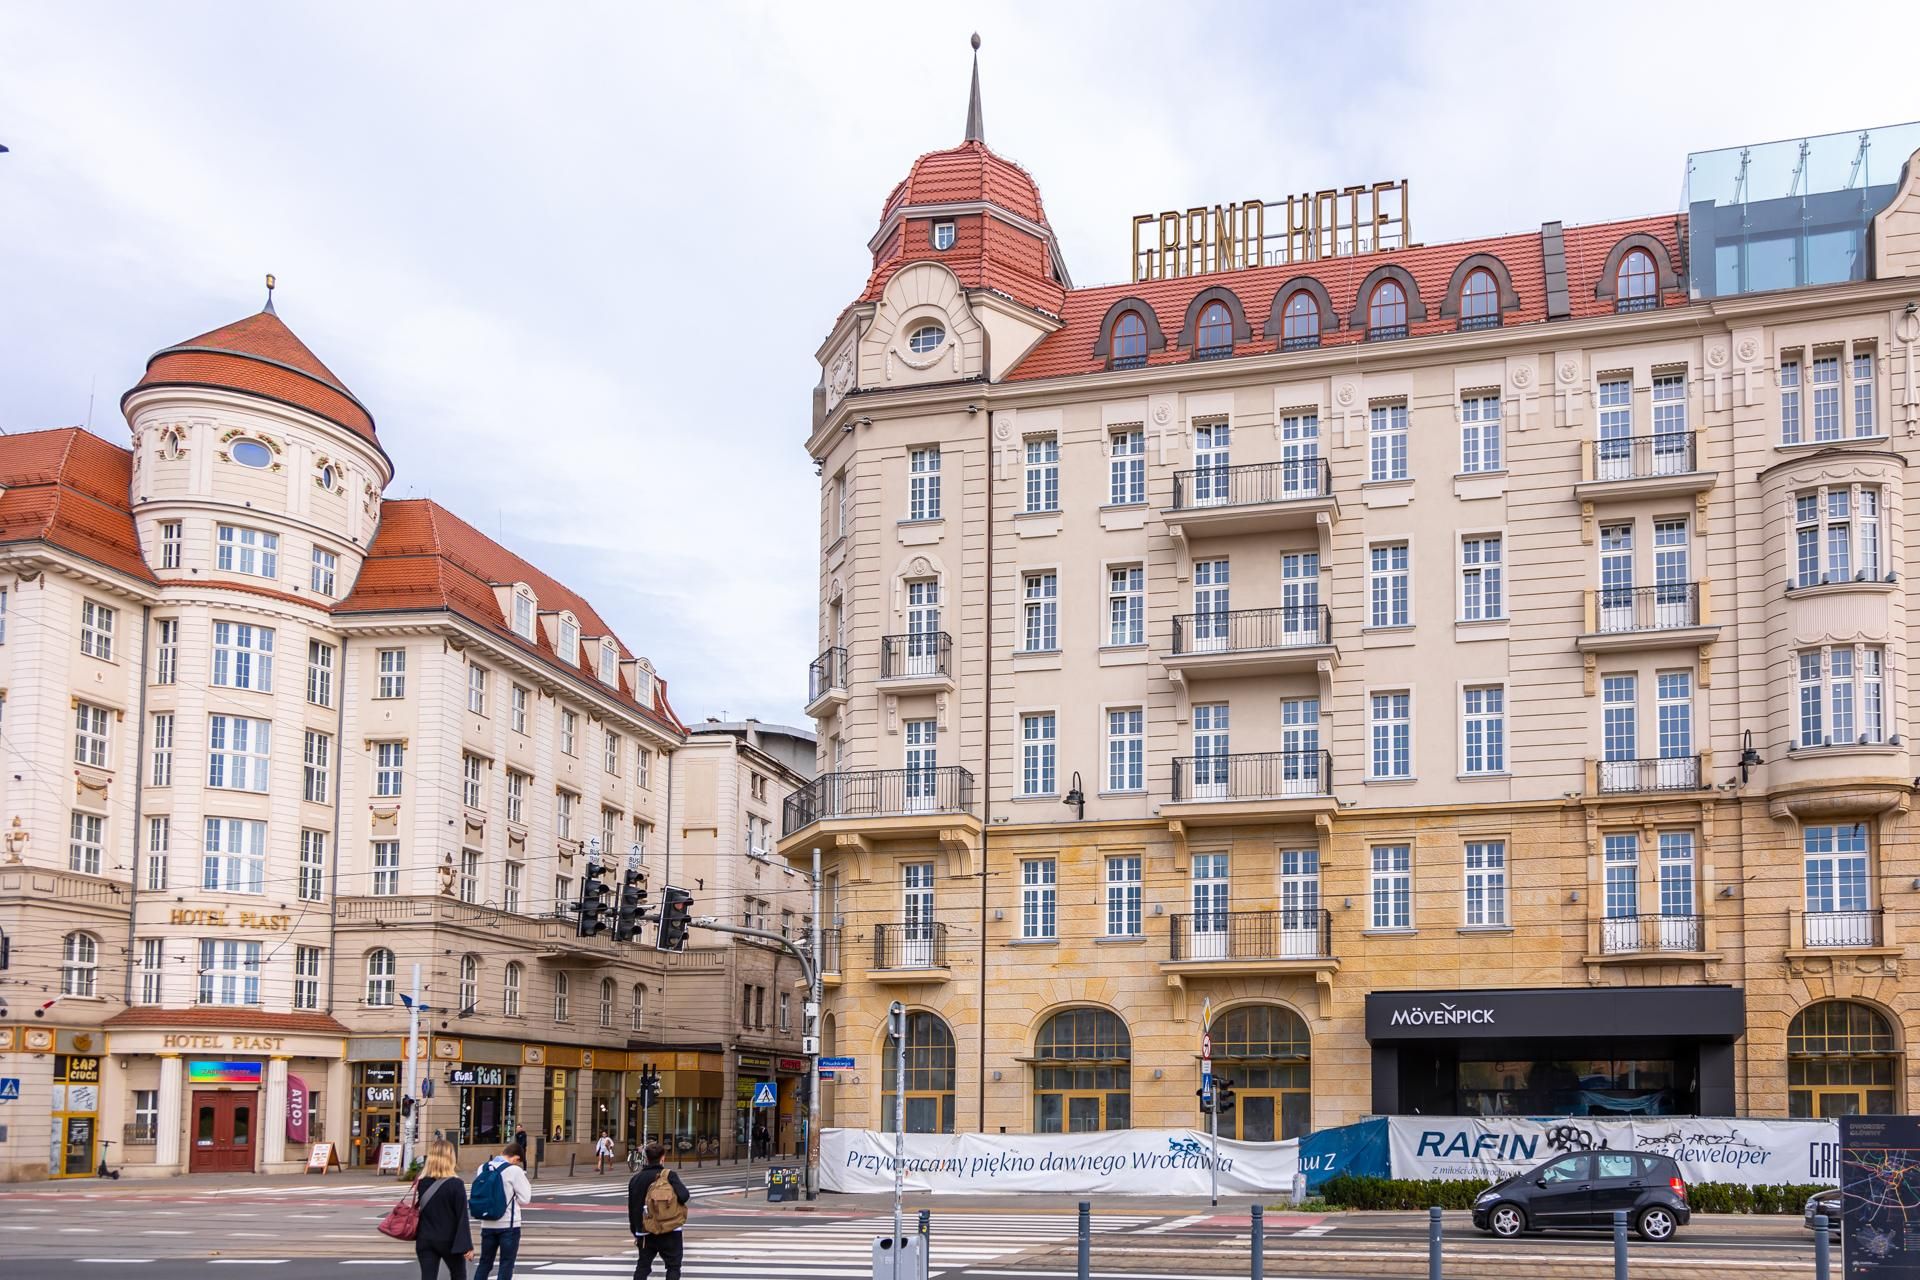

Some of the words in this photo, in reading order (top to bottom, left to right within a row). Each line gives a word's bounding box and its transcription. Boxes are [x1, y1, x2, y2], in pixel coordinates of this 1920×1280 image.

[1132, 199, 1264, 283] GRAND
[1287, 179, 1424, 263] HOTEL
[170, 909, 229, 927] HOTEL
[239, 911, 291, 931] PIAST
[1391, 1002, 1495, 1025] MÖVENPICK
[163, 1034, 223, 1049] HOTEL
[232, 1036, 285, 1050] PIAST
[1416, 1131, 1540, 1160] RAFIN
[1673, 1144, 1772, 1168] deweloper
[971, 1152, 1035, 1177] piękno
[1039, 1151, 1126, 1176] dawnego
